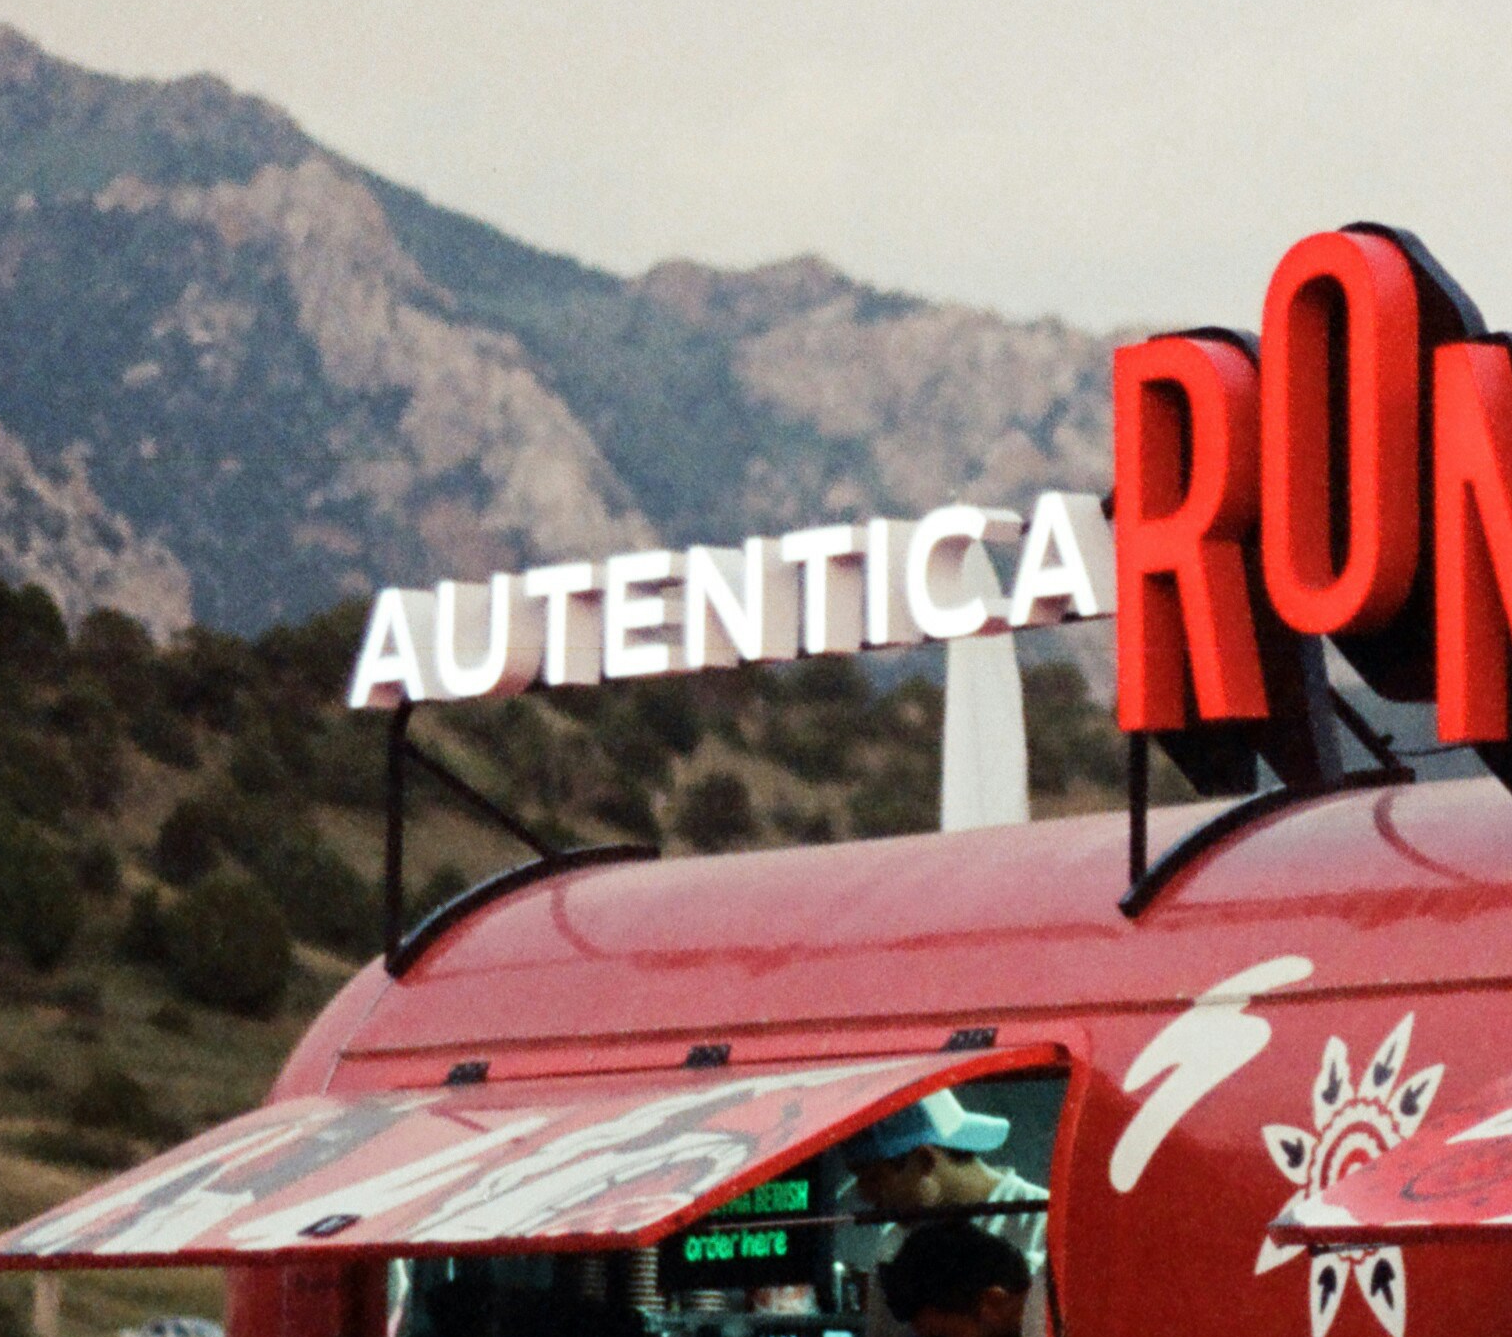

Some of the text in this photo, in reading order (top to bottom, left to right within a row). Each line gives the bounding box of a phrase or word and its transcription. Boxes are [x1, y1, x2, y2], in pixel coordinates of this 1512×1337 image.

[349, 492, 1118, 708] AUTENTICA
[684, 1226, 788, 1261] order here
